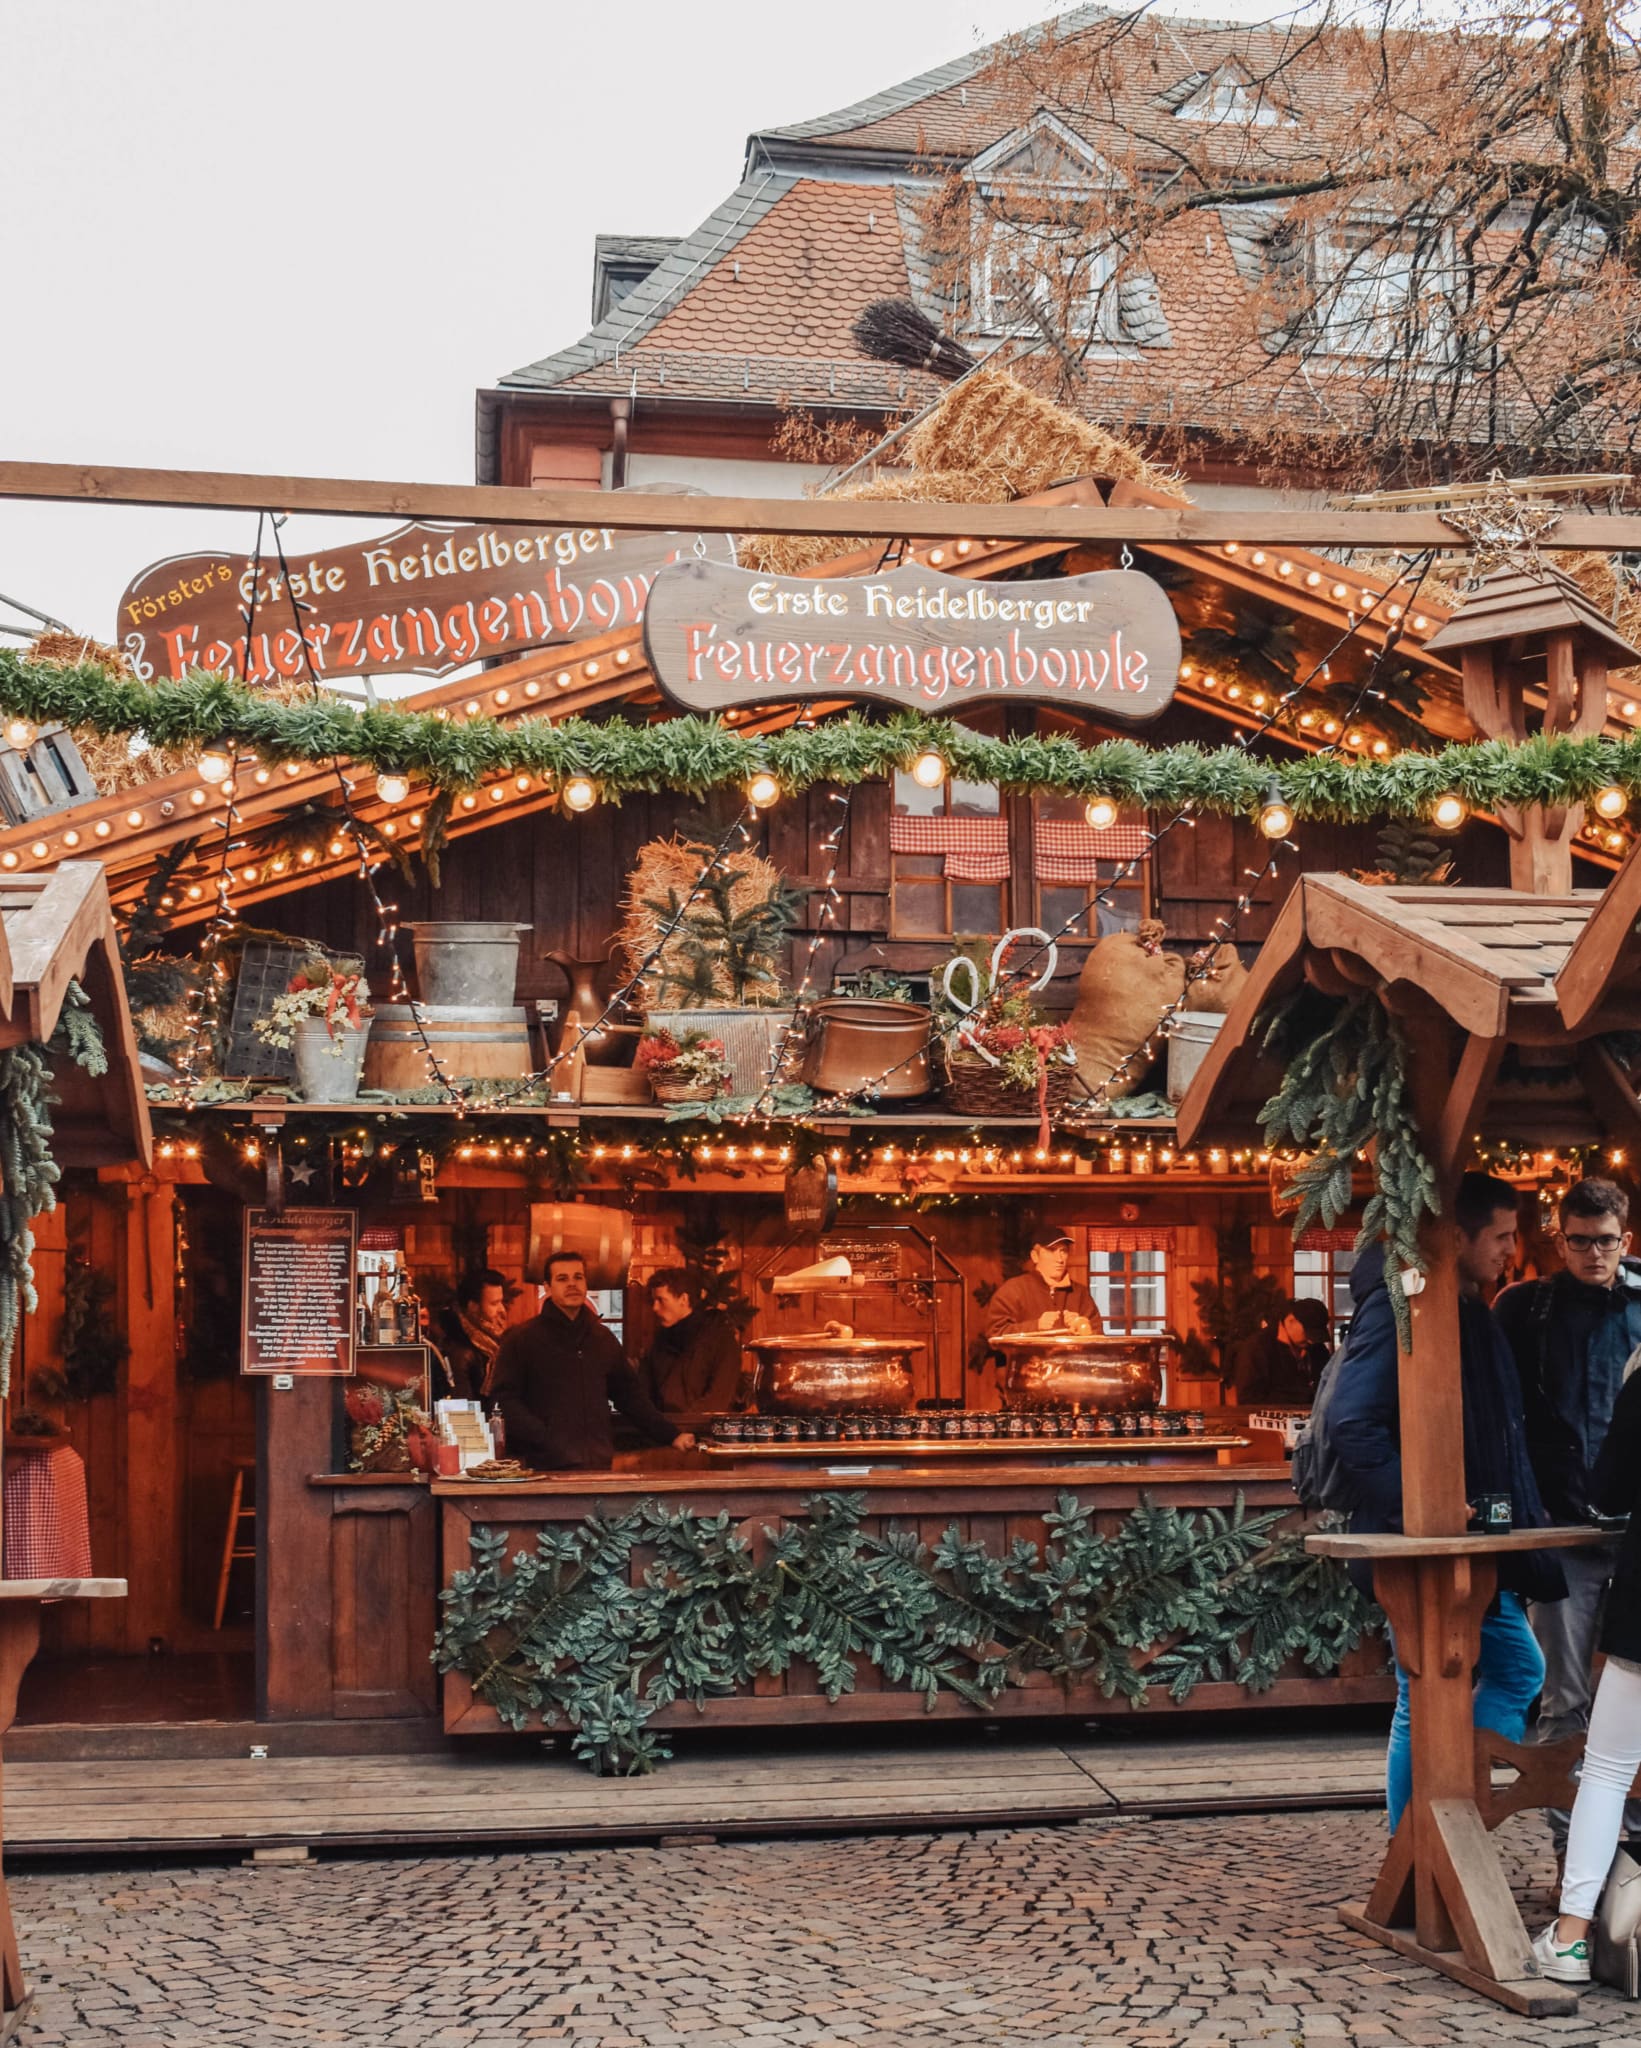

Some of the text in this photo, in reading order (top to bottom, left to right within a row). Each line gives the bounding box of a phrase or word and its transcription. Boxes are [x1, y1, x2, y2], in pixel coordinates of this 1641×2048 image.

[124, 563, 232, 625] Förster's
[238, 528, 616, 606] Erste Heidelberger
[747, 581, 1094, 629] Erste Heidelberger
[158, 550, 680, 686] Feuerzangenbow
[680, 619, 1149, 700] Feuerzangenbowle
